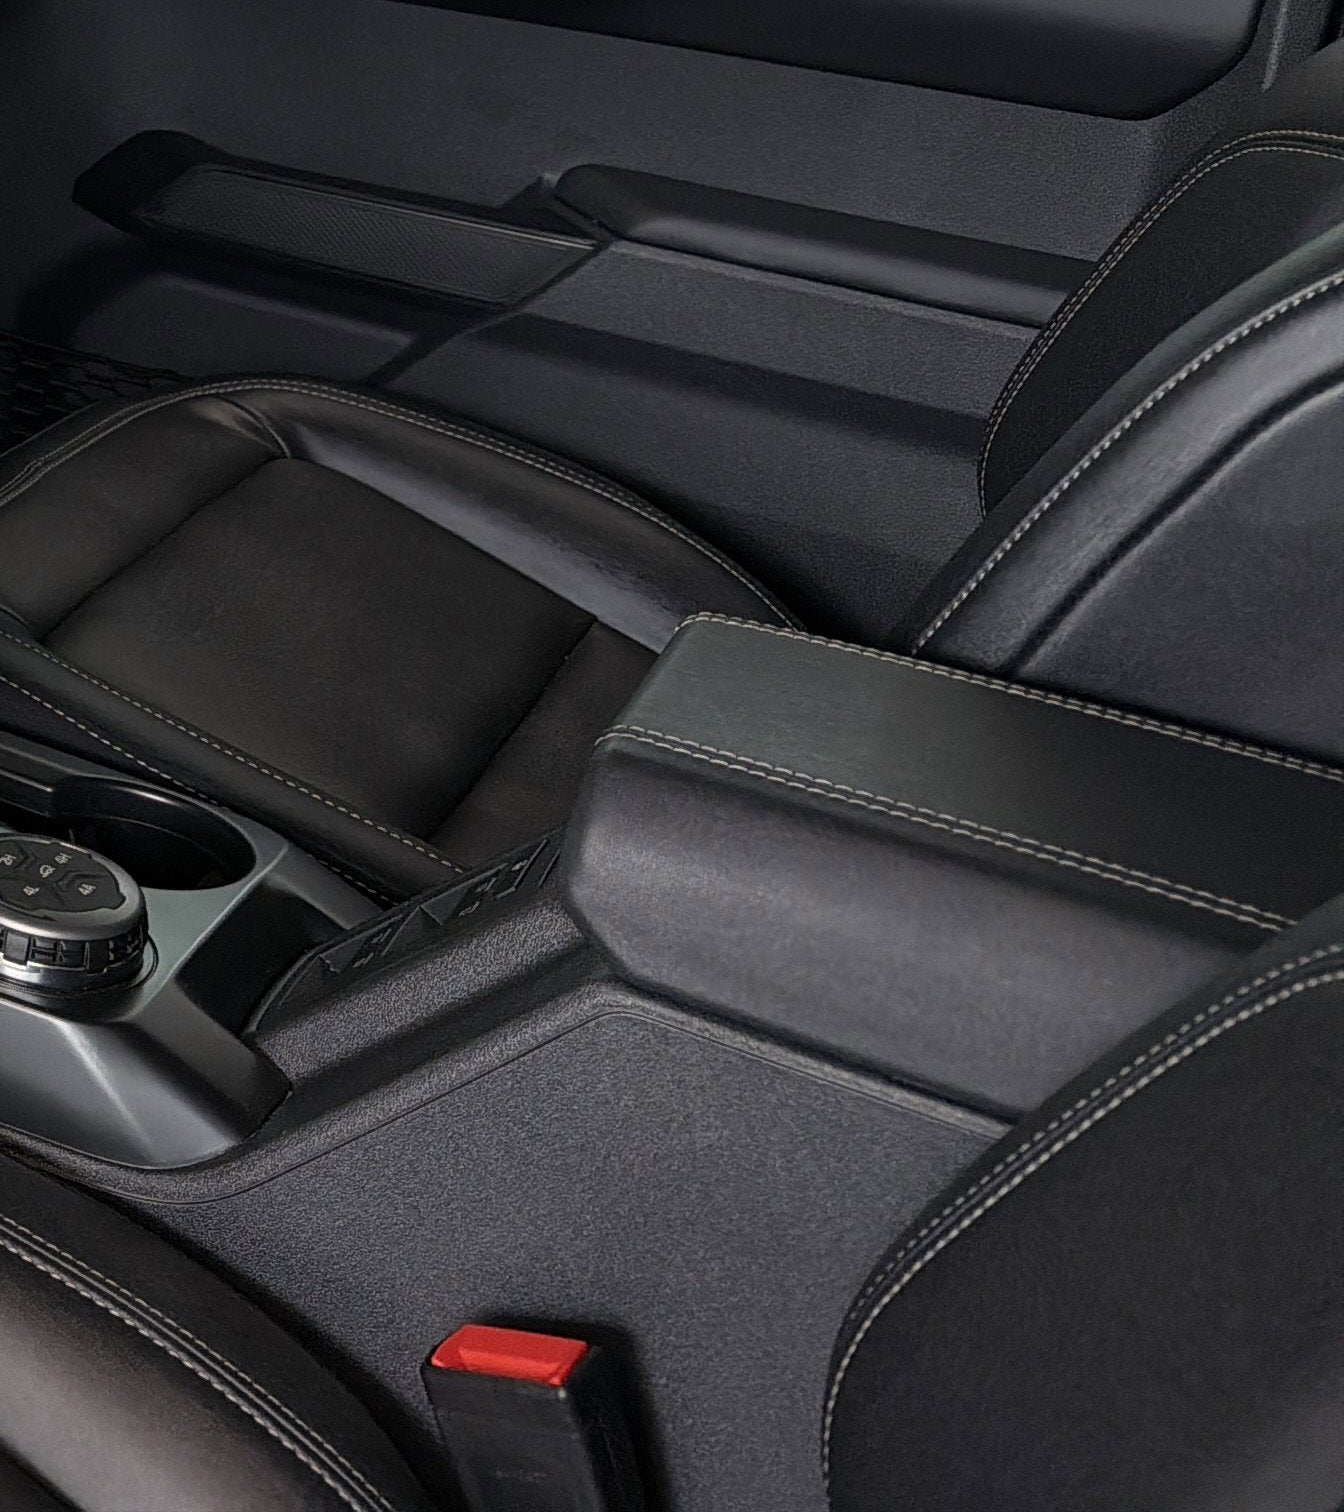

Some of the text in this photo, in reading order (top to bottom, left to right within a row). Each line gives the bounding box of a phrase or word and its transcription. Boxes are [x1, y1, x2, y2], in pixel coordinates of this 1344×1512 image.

[54, 852, 72, 865] 4H
[22, 885, 41, 897] 4L
[78, 883, 97, 897] 4A
